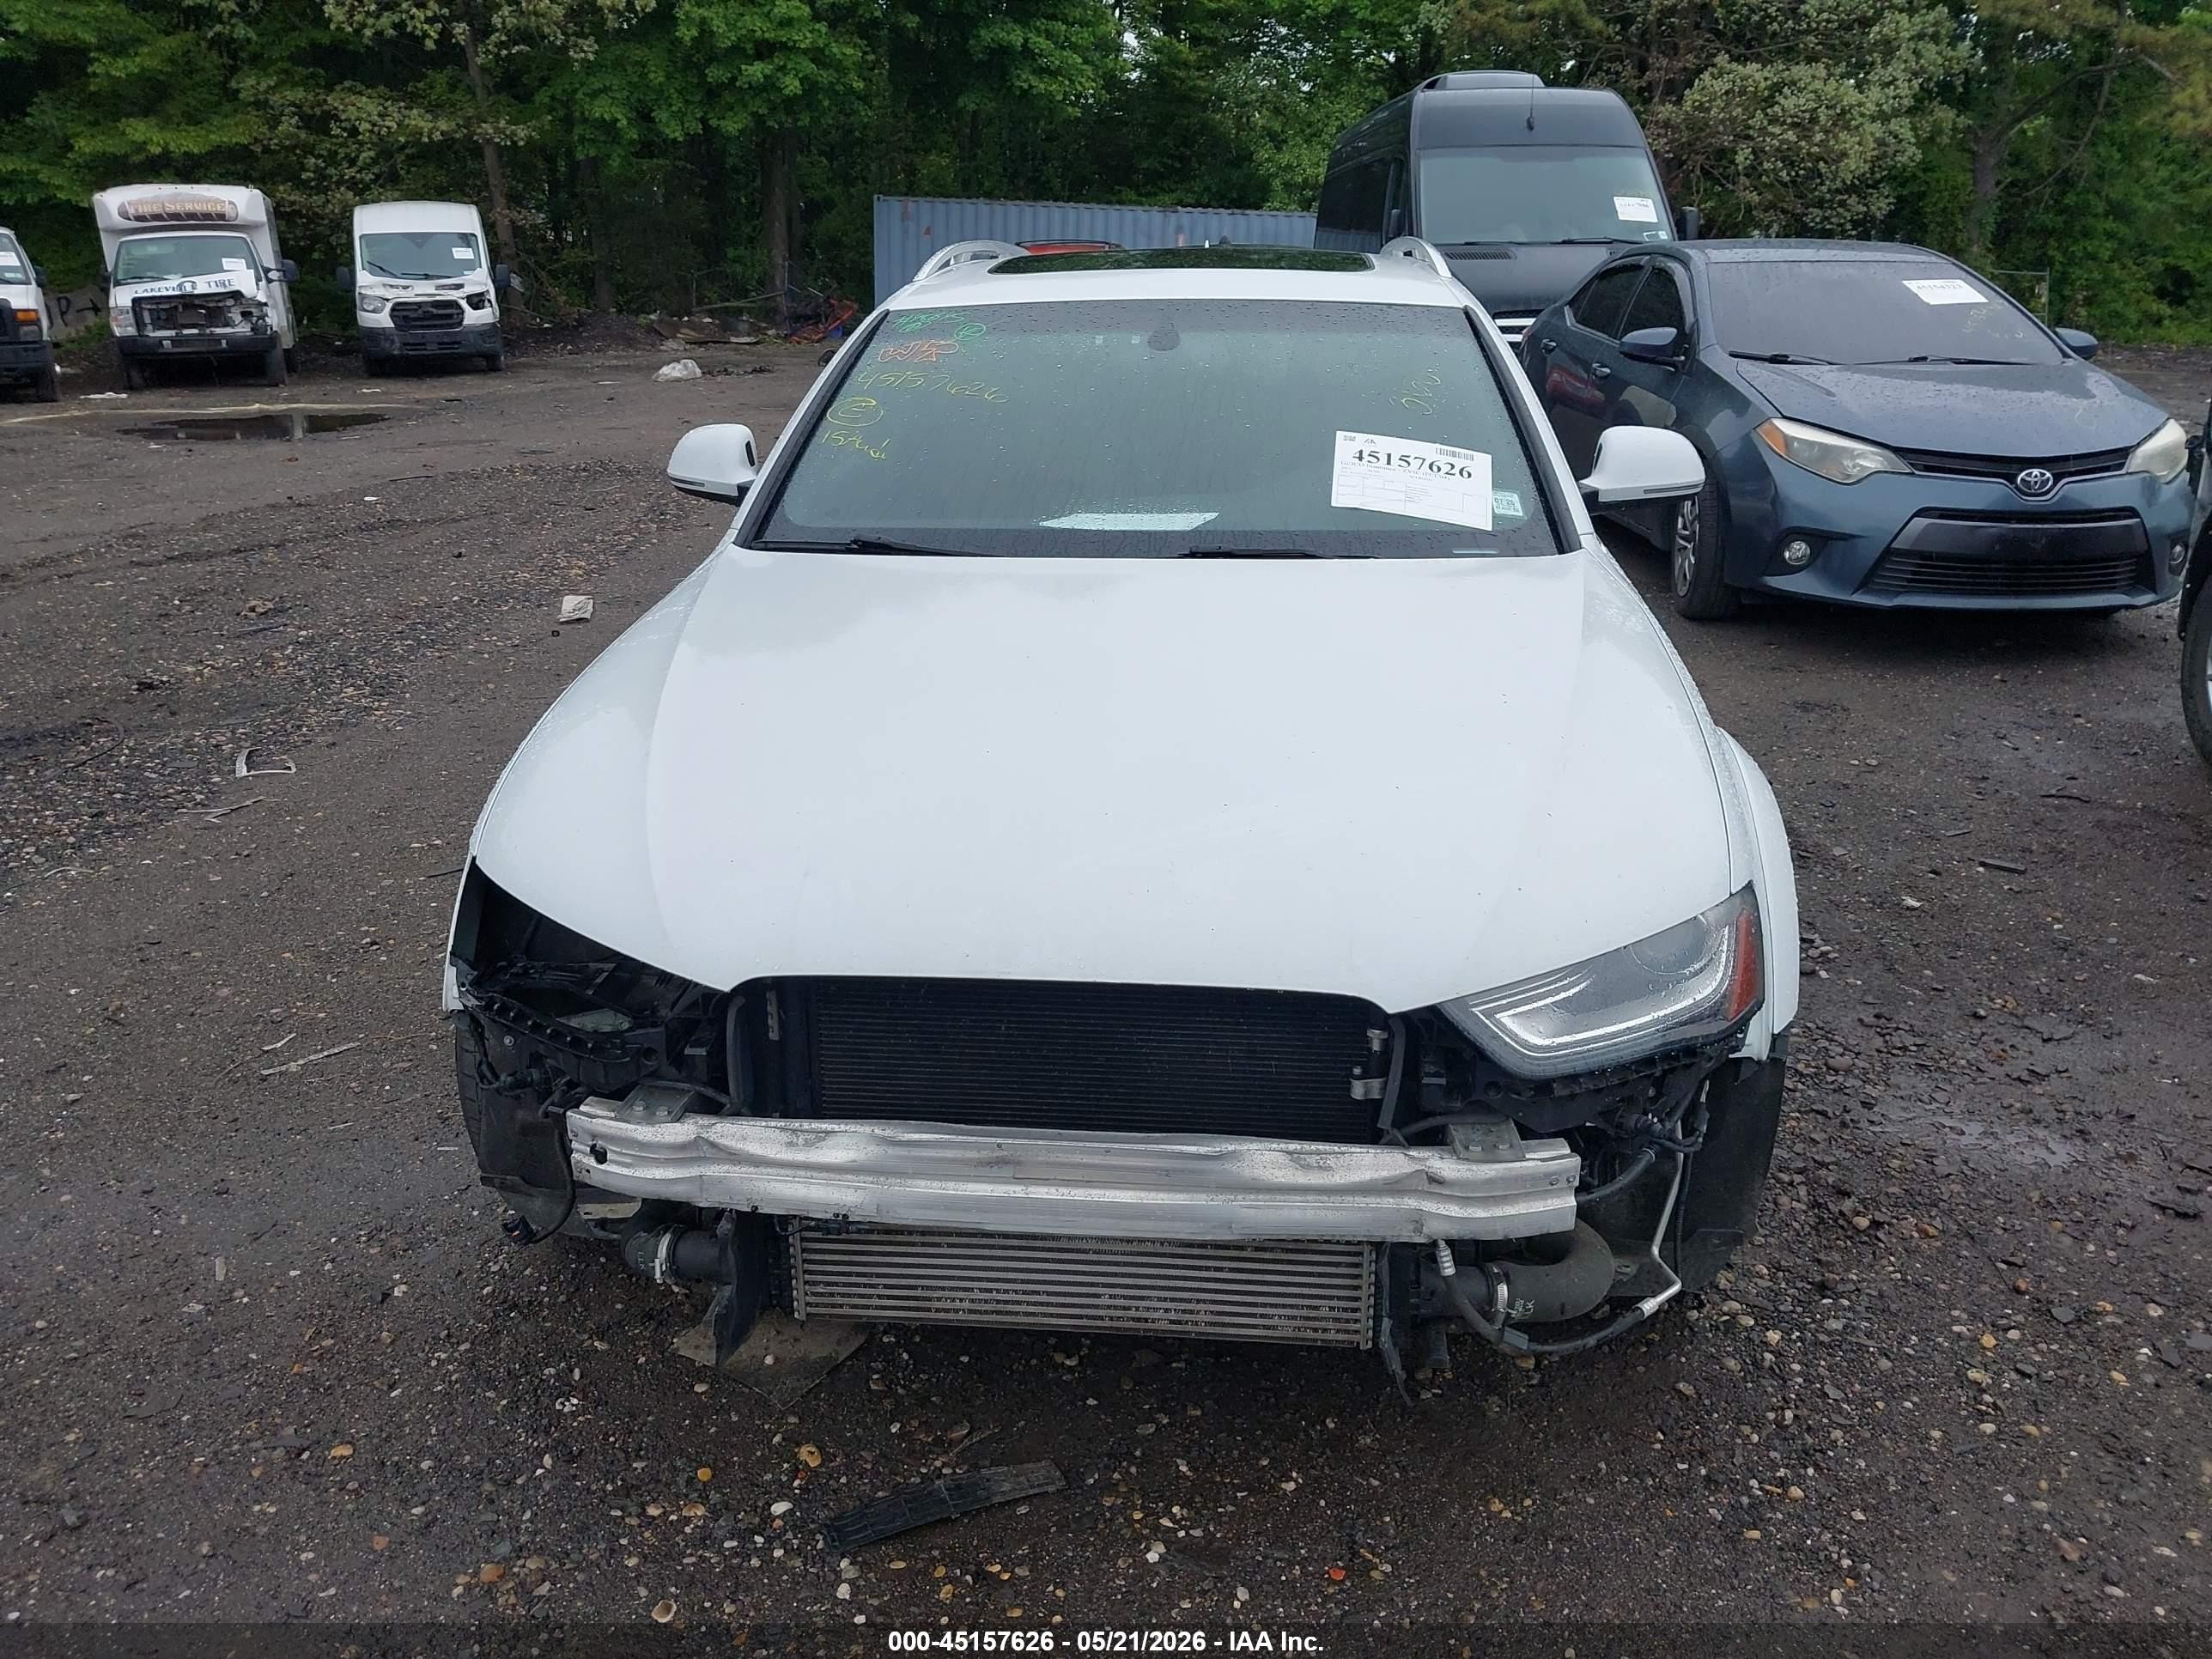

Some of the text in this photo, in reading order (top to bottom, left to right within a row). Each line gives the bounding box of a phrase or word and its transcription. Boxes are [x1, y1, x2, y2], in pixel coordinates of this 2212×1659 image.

[163, 201, 226, 212] SERVICE
[204, 278, 235, 290] TIRE
[858, 371, 1010, 403] 45157626
[1352, 448, 1473, 480] 45157626
